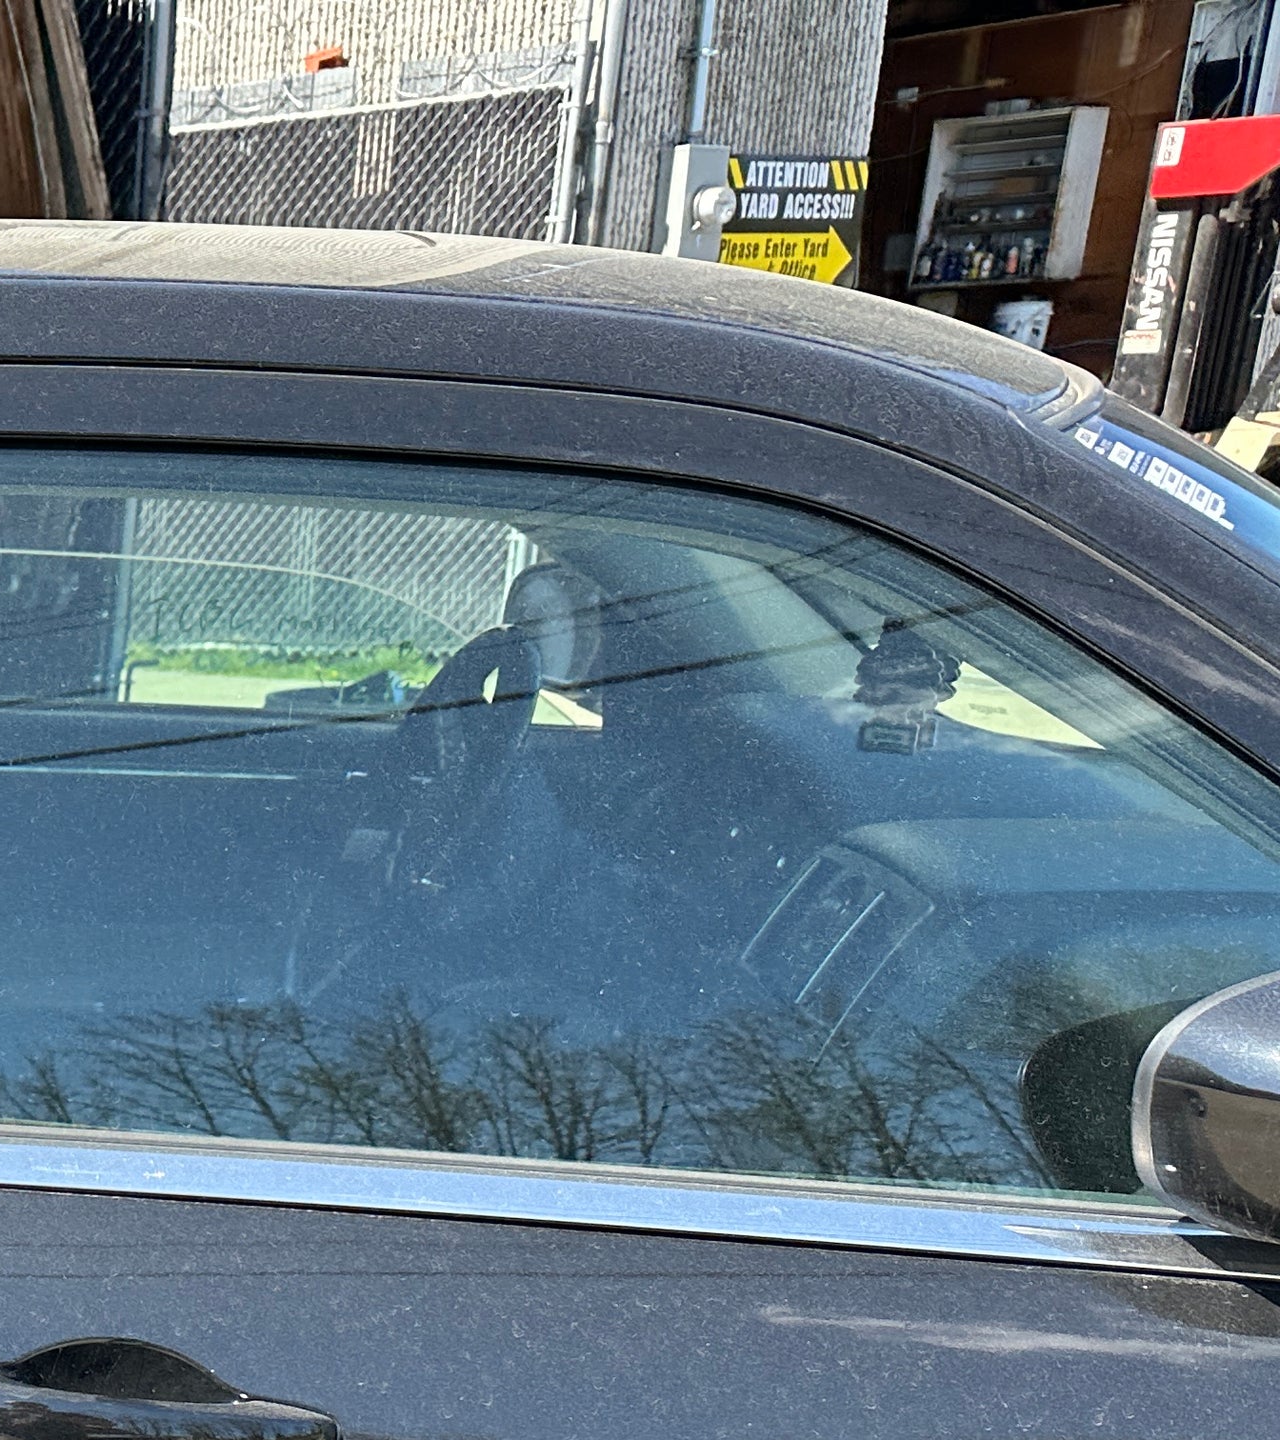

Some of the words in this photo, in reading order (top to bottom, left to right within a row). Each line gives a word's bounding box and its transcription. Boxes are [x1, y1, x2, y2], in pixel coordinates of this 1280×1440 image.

[745, 160, 830, 189] ATTENTION
[740, 193, 780, 220] YARD
[782, 192, 856, 220] ACCESS!!!
[720, 238, 760, 261] Please
[764, 238, 798, 259] Enter
[803, 237, 830, 259] Yard
[1135, 213, 1179, 331] NISSAN
